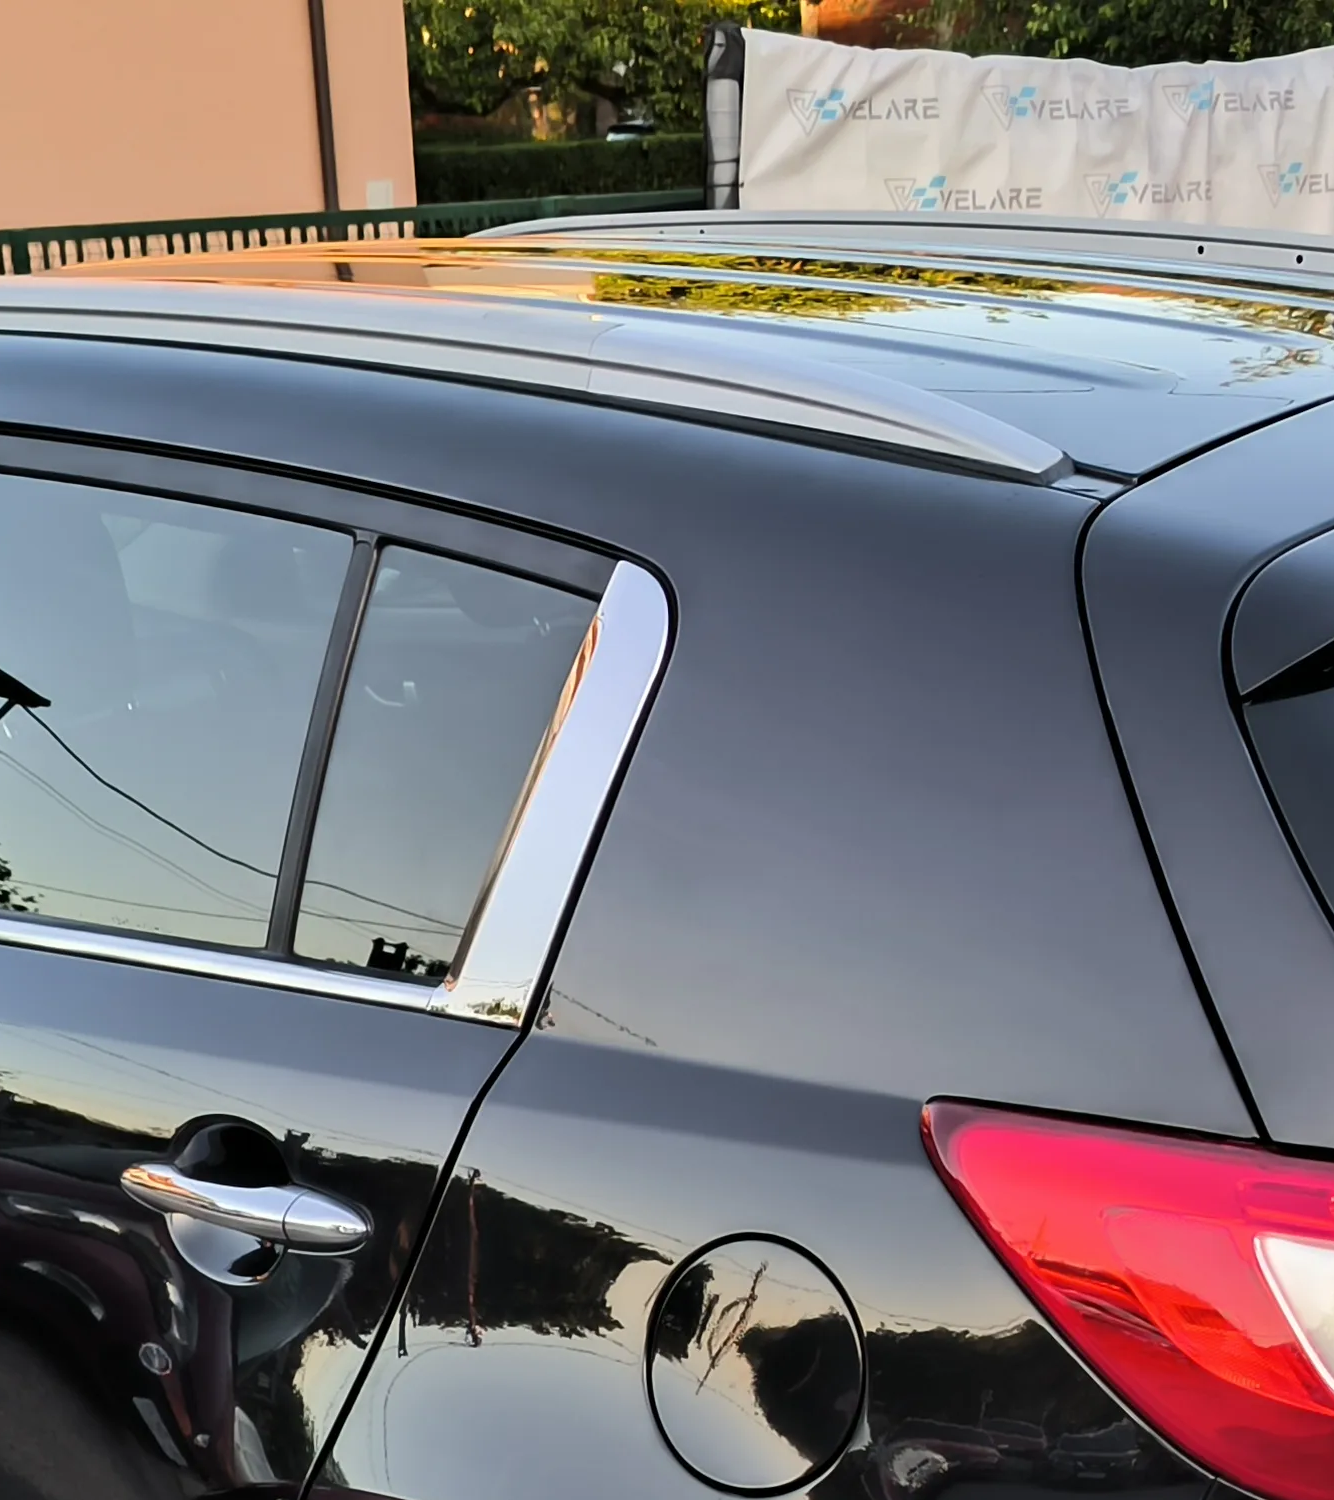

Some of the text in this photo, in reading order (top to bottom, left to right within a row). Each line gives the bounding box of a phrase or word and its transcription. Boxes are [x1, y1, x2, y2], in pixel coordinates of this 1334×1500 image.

[840, 98, 940, 120] VELARE
[1030, 98, 1132, 121] VELARE
[939, 187, 1042, 211] VELARE
[1130, 180, 1212, 204] VELARE
